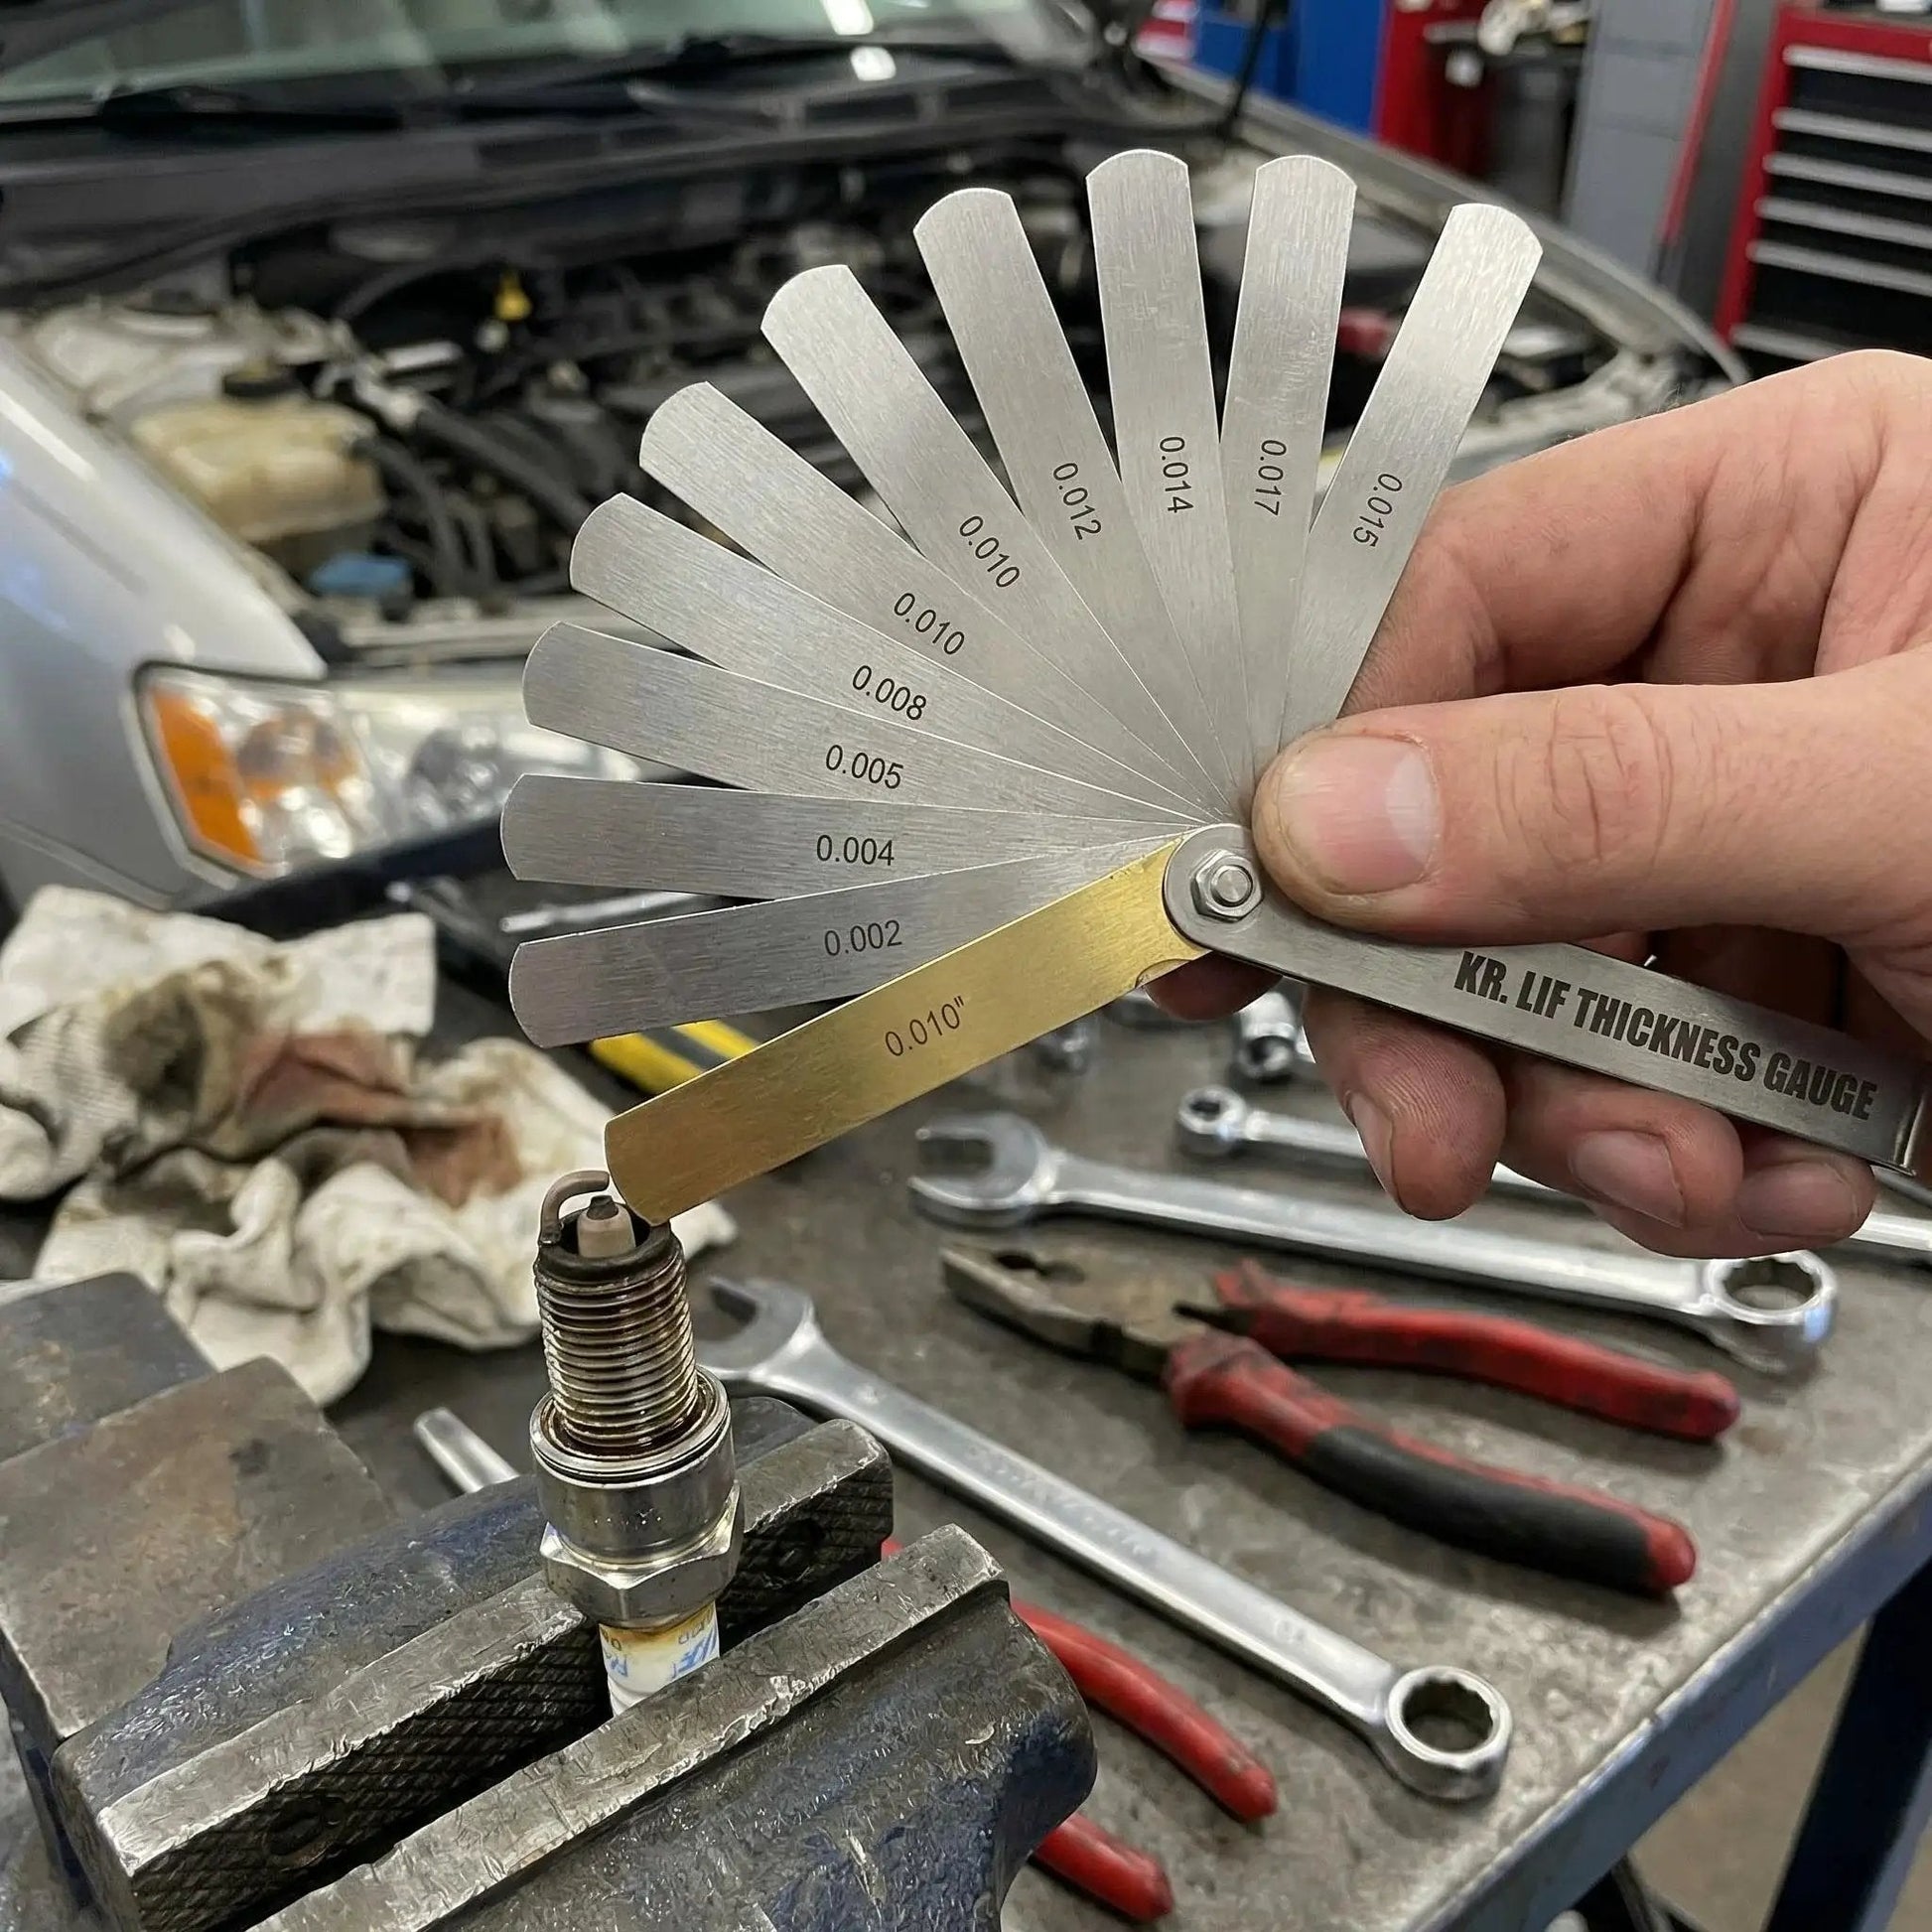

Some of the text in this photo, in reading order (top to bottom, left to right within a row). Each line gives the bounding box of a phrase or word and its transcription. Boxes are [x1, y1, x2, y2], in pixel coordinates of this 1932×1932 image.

[1052, 462, 1102, 541] 0.012
[1159, 436, 1194, 514] 0.014
[1254, 439, 1288, 516] 0.017
[1352, 473, 1403, 548] 0.015
[959, 515, 1021, 588] 0.010
[894, 592, 965, 655] 0.010
[852, 664, 927, 721] 0.008
[825, 744, 904, 790] 0.005
[816, 834, 896, 867] 0.004
[824, 919, 902, 957] 0.002
[885, 995, 964, 1057] 0.010"
[1453, 951, 1876, 1121] KR. LIF THICKNESS GAUGE
